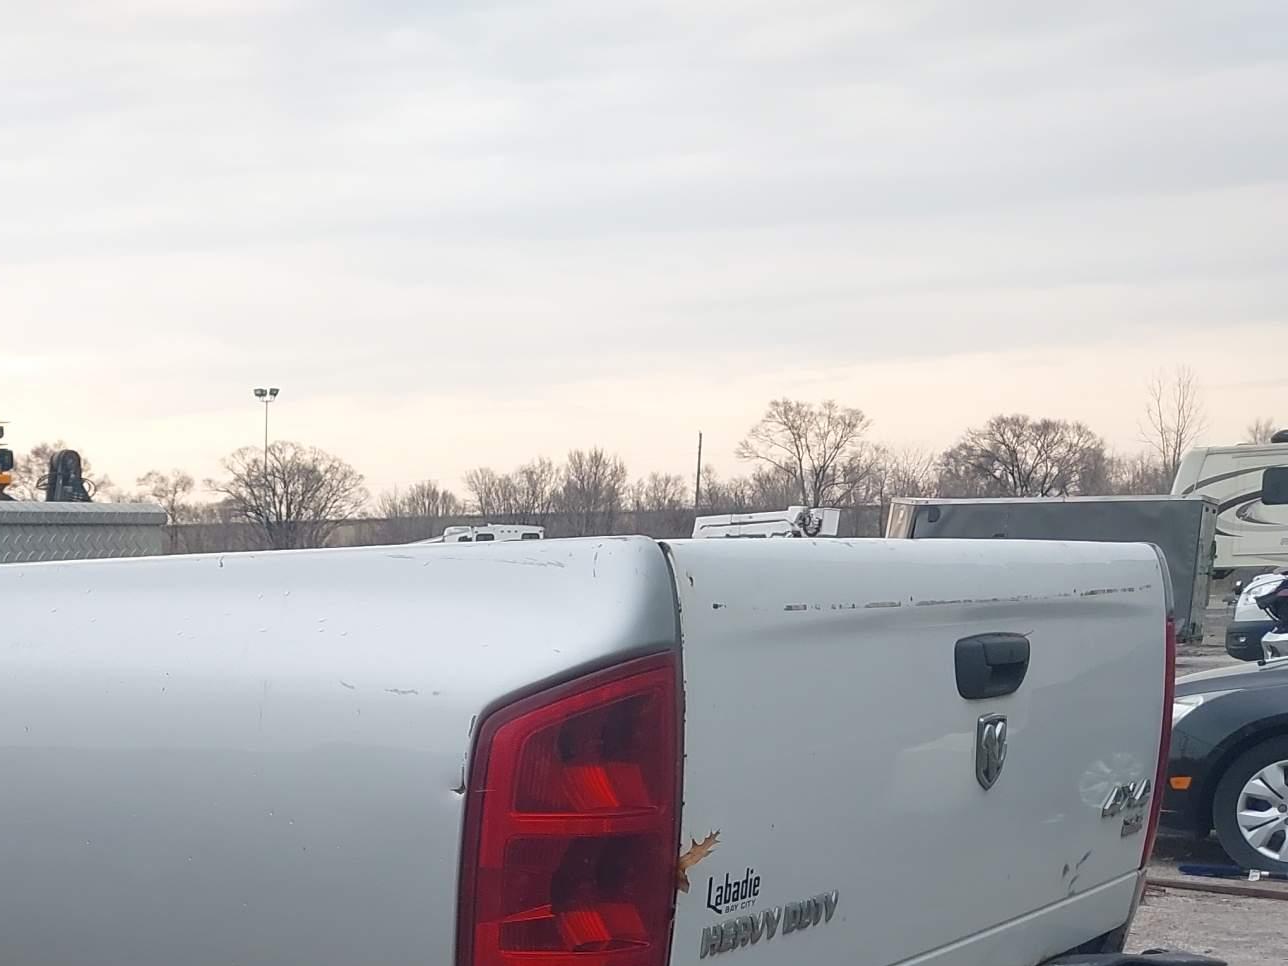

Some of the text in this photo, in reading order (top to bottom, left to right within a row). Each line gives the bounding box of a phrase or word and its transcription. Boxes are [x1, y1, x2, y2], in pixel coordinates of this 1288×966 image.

[707, 867, 761, 915] Labadie
[724, 899, 757, 914] BAY CITY
[700, 888, 840, 960] HEAVY DUTY
